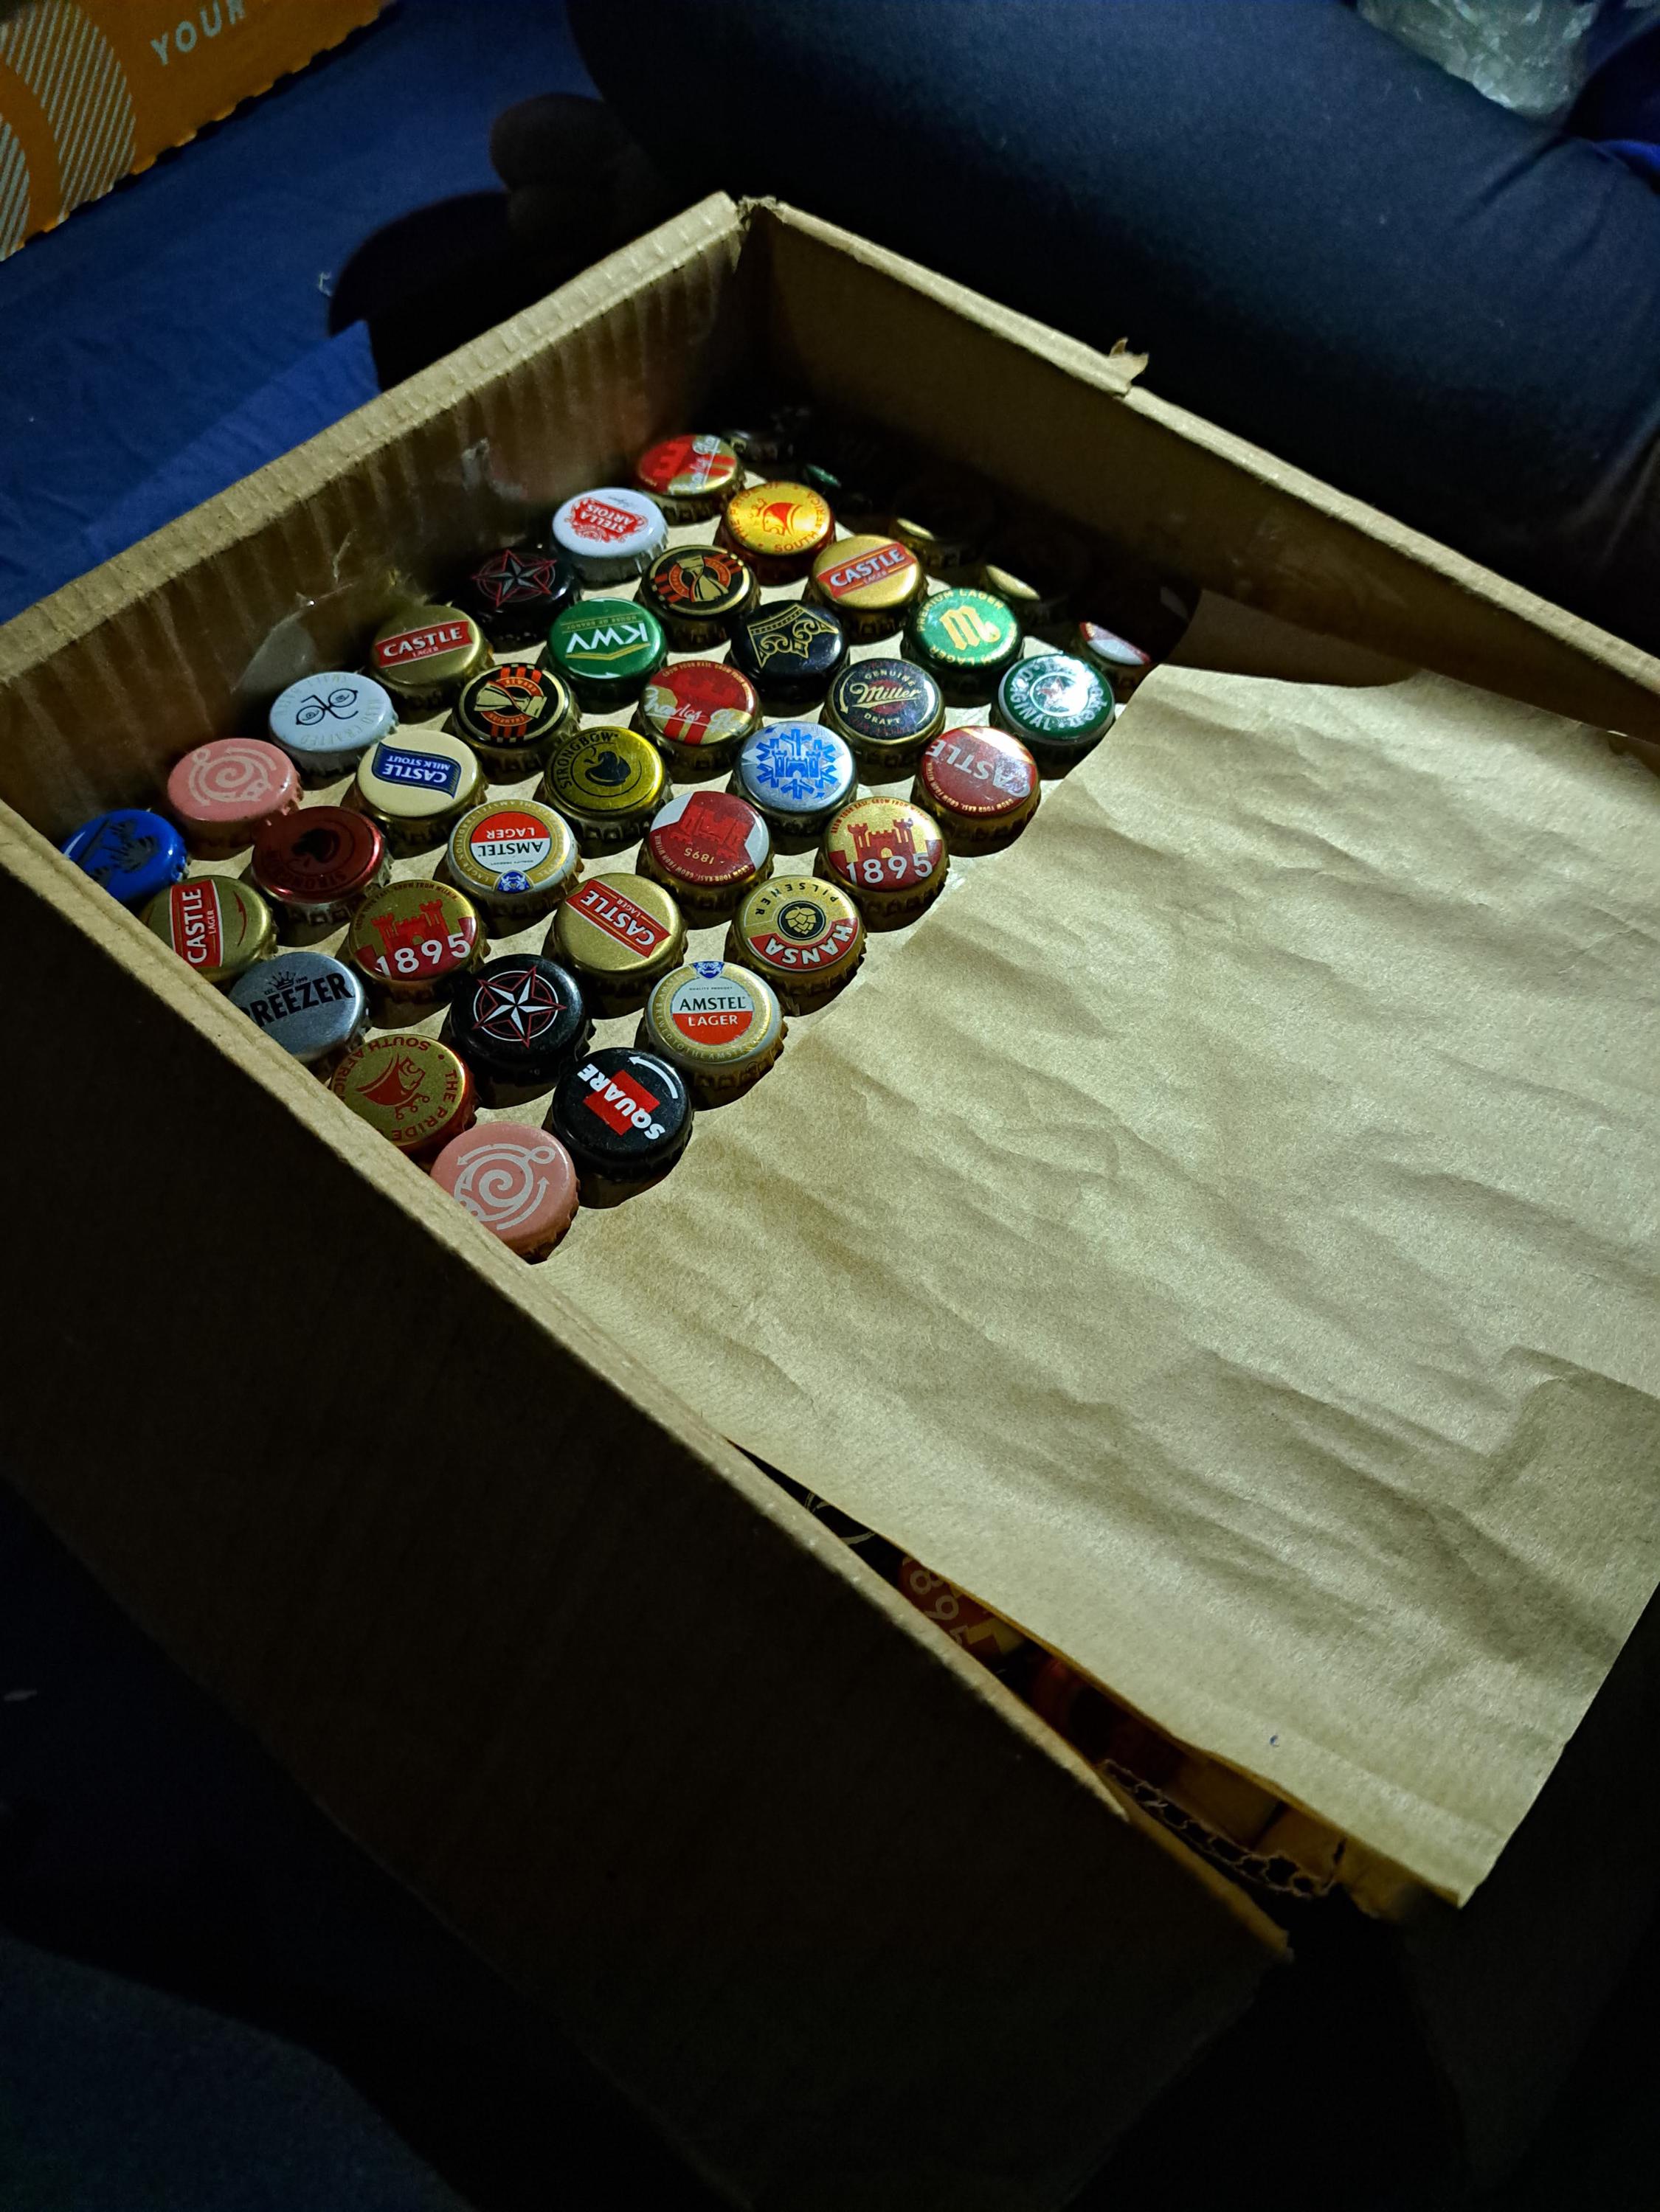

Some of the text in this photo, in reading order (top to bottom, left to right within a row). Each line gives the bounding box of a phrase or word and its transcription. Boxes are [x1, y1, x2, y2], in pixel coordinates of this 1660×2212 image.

[581, 511, 626, 533] STELLA
[587, 505, 634, 524] ARTOIS
[774, 531, 819, 552] SOUTH
[829, 548, 905, 588] CASTLE
[917, 589, 1004, 632] PREMIUM LAGER
[383, 626, 463, 658] CASTLE
[566, 621, 649, 653] KWV
[412, 645, 439, 658] LAGER
[864, 668, 916, 687] GENUINE
[849, 682, 921, 704] Miller
[863, 713, 901, 725] DRAFT
[386, 754, 451, 772] MILK STOUT
[556, 732, 614, 790] STRONGBOW
[924, 738, 1031, 797] CASTLE
[382, 763, 448, 784] CASTLE
[486, 827, 536, 839] LAGER
[477, 841, 544, 857] AMSTEL
[683, 847, 715, 864] 1895
[675, 866, 694, 878] GROW
[845, 853, 934, 885] 1895
[617, 899, 642, 918] LAGER
[755, 882, 840, 915] PILSENER
[181, 888, 207, 964] CASTLE
[207, 909, 216, 935] LAGER
[580, 890, 656, 946] CASTLE
[376, 932, 471, 977] 1895
[765, 924, 854, 965] HANSA
[679, 996, 747, 1011] AMSTEL
[688, 1014, 739, 1027] LAGER
[369, 1036, 431, 1053] SOUTH
[392, 1069, 457, 1142] THE PRIDE
[577, 1063, 666, 1140] SQUARE
